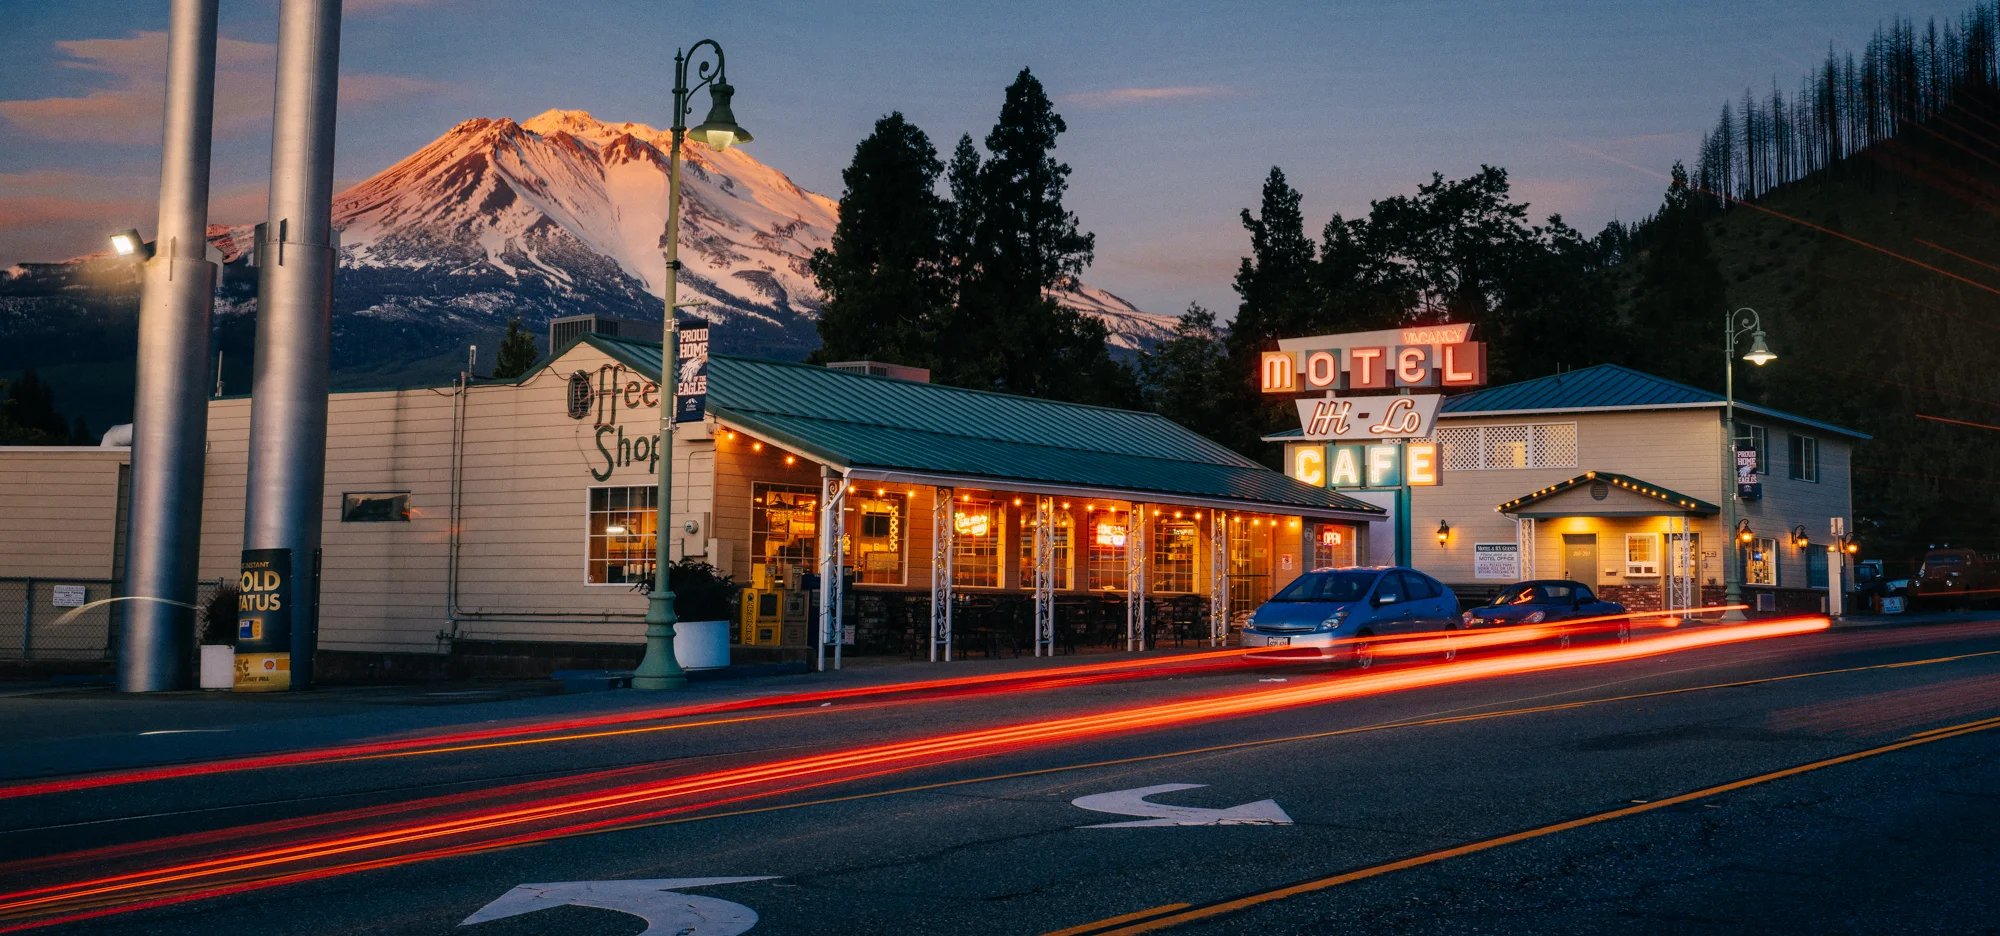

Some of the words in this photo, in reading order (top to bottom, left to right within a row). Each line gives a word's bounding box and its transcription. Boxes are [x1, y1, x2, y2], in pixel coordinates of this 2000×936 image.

[680, 328, 708, 342] PROUD
[1403, 329, 1463, 345] VACANCY
[679, 341, 708, 359] HOME
[1263, 346, 1473, 389] MOTEL
[678, 382, 707, 396] EAGLES
[1737, 450, 1756, 458] PROUD
[1737, 457, 1756, 466] HOME
[1295, 446, 1434, 485] CAFE
[1738, 476, 1757, 484] EAGLES
[1324, 532, 1341, 545] OPEN
[240, 570, 281, 592] OLD
[239, 593, 281, 612] TATUS
